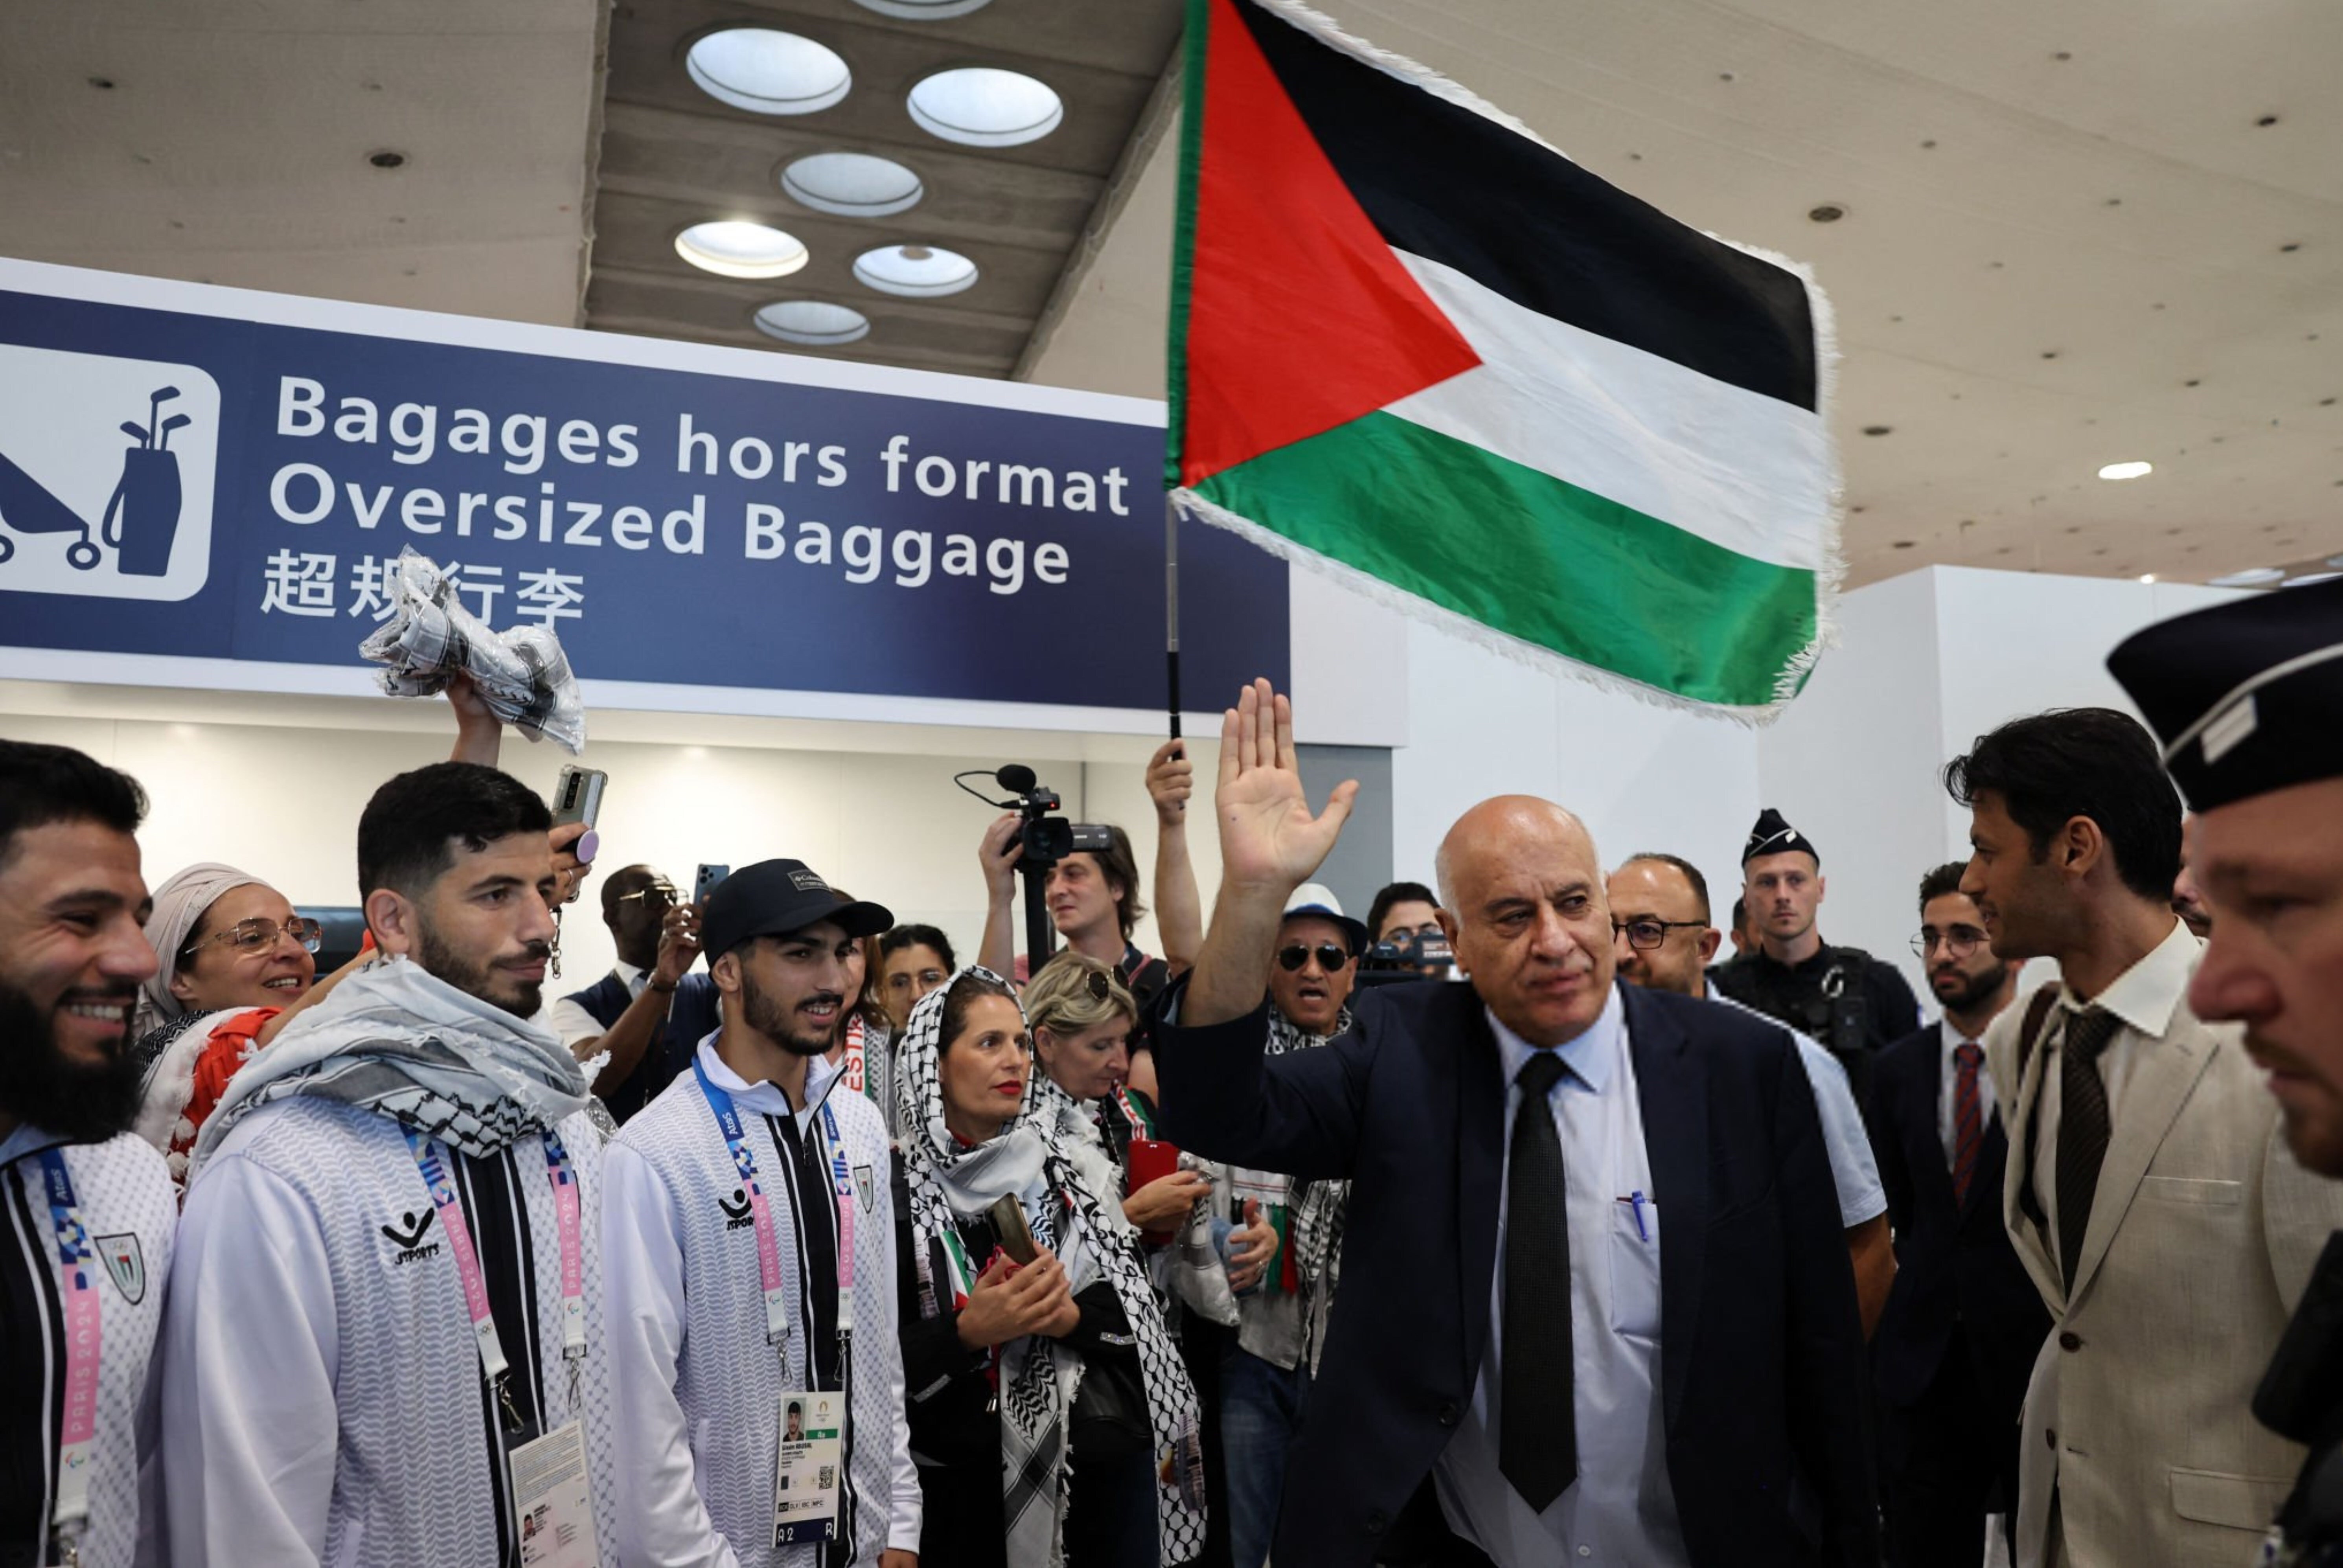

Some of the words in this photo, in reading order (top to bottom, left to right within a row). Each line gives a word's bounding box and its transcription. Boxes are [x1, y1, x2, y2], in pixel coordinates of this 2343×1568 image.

[277, 375, 639, 474] Bagages
[677, 413, 847, 487] hors
[880, 435, 1129, 516] format
[270, 463, 706, 555] Oversized
[745, 503, 1070, 595] Baggage
[562, 1193, 574, 1235] 2024
[757, 1203, 771, 1238] 2024
[842, 1203, 851, 1241] PARIS
[447, 1213, 471, 1262] PARIS
[465, 1267, 484, 1312] 2024
[566, 1241, 577, 1289] PARIS
[763, 1243, 776, 1284] PARIS
[76, 1301, 92, 1359] 2024
[71, 1367, 90, 1433] PARIS
